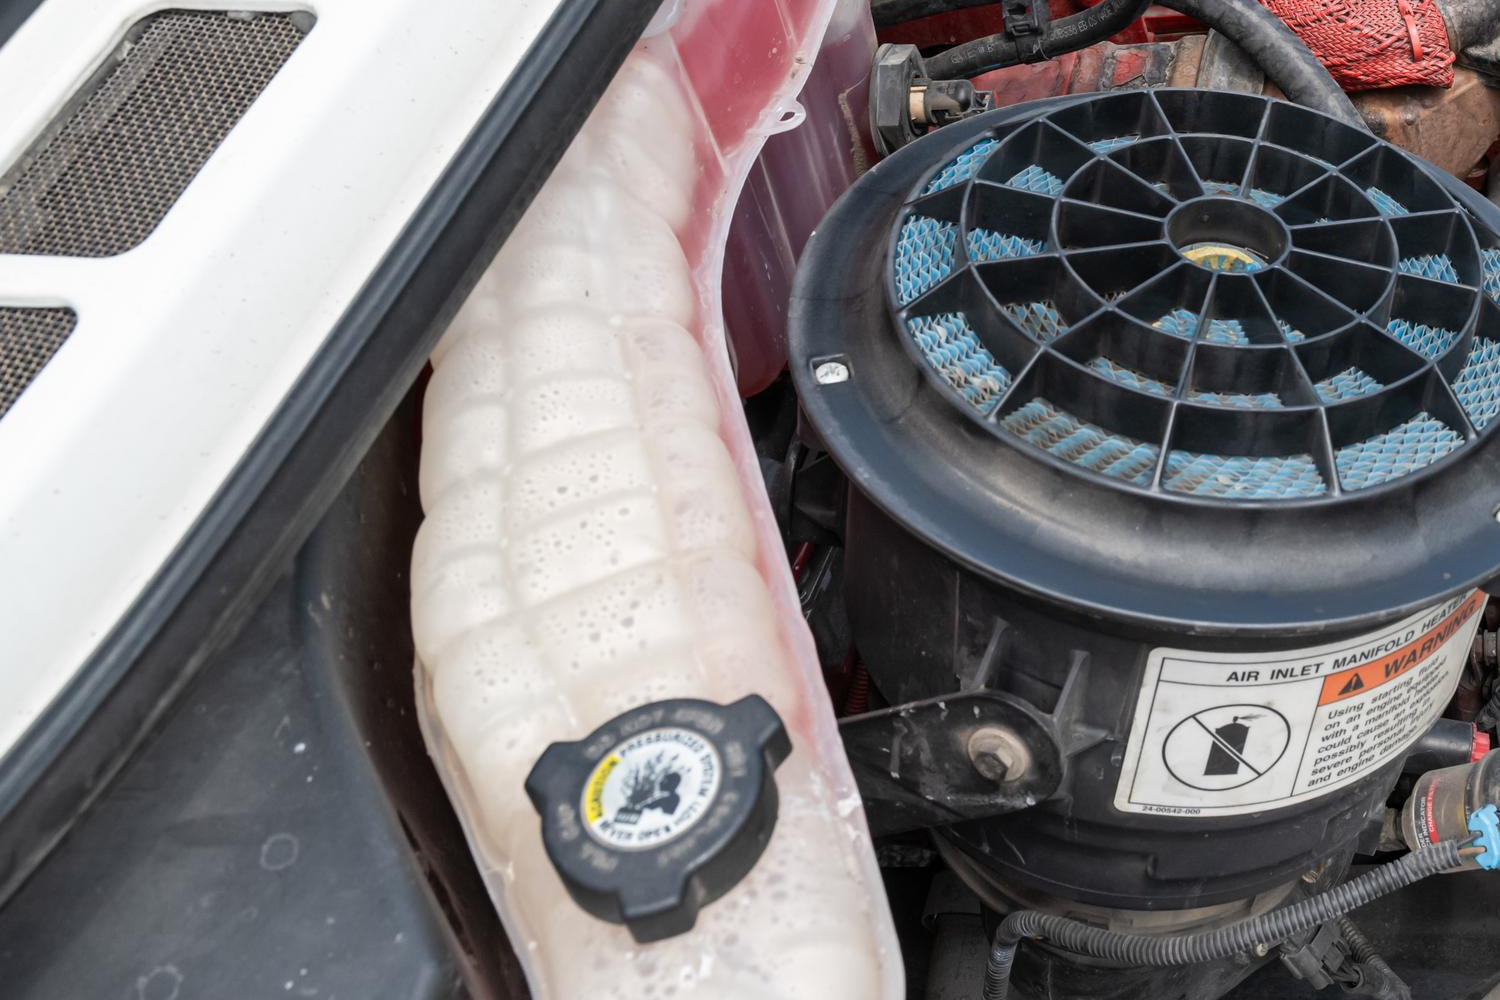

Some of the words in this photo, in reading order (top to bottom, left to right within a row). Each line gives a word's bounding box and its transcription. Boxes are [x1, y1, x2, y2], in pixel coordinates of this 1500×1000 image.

[1226, 670, 1260, 682] AIR
[1269, 662, 1325, 680] INLET
[1332, 629, 1415, 670] MANIFOLD
[1421, 592, 1467, 633] HEATER
[1383, 600, 1477, 678] WARNING
[1321, 728, 1346, 742] with
[1365, 696, 1411, 726] manifold
[1324, 721, 1340, 731] on
[1346, 713, 1361, 724] an
[1366, 693, 1402, 716] engine
[1328, 702, 1365, 719] Using
[1371, 676, 1414, 703] starting
[1311, 755, 1353, 776] severe
[1358, 726, 1405, 759] personal
[1314, 740, 1366, 767] possibly
[1373, 708, 1418, 740] resulting
[1318, 736, 1352, 754] could
[1357, 719, 1389, 739] cause
[1307, 773, 1331, 787] and
[1336, 755, 1375, 777] engine
[1421, 797, 1429, 838] INDICATOR
[1427, 803, 1435, 832] CHANGE
